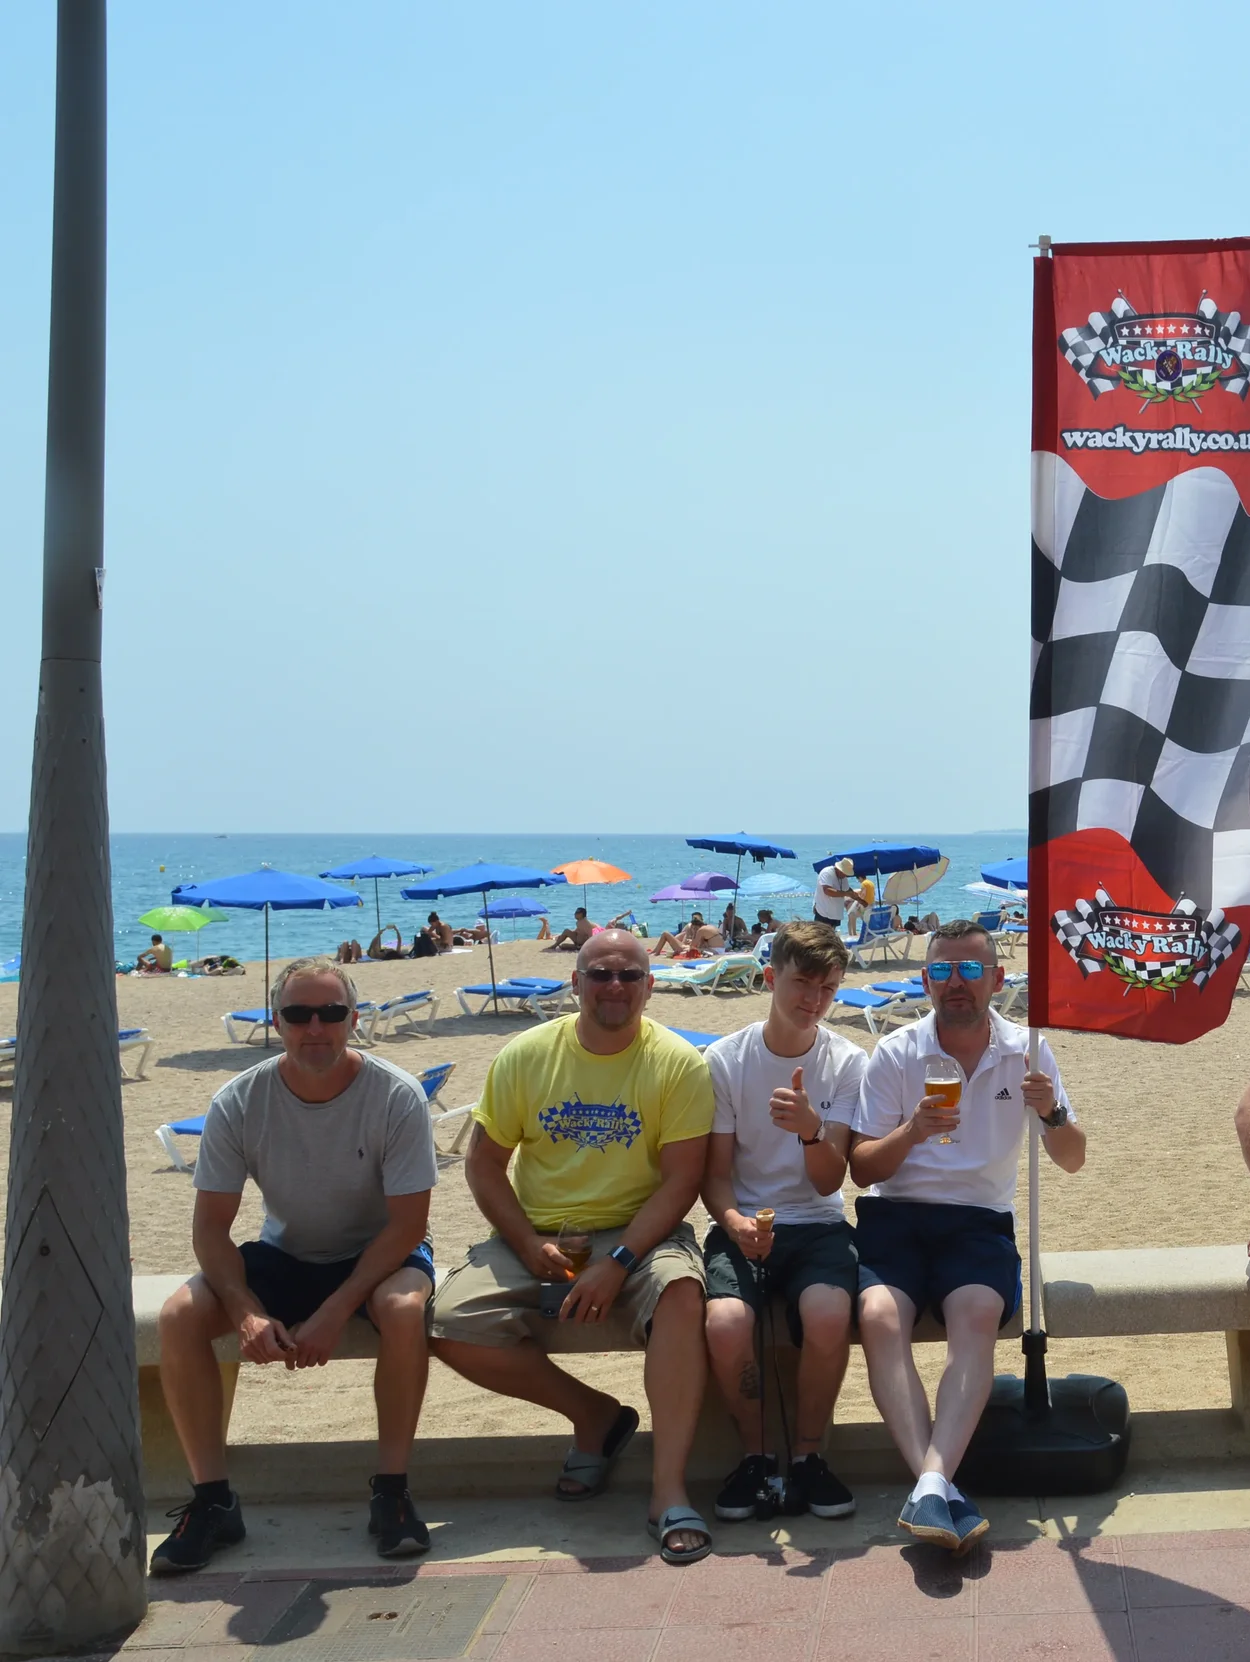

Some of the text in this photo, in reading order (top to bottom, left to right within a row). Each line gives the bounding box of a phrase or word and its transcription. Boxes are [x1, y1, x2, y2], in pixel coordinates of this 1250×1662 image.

[1099, 341, 1172, 367] Wack
[1175, 341, 1234, 369] Rally
[1086, 931, 1208, 961] Wacky Rally
[558, 1117, 626, 1132] Wacky Rally
